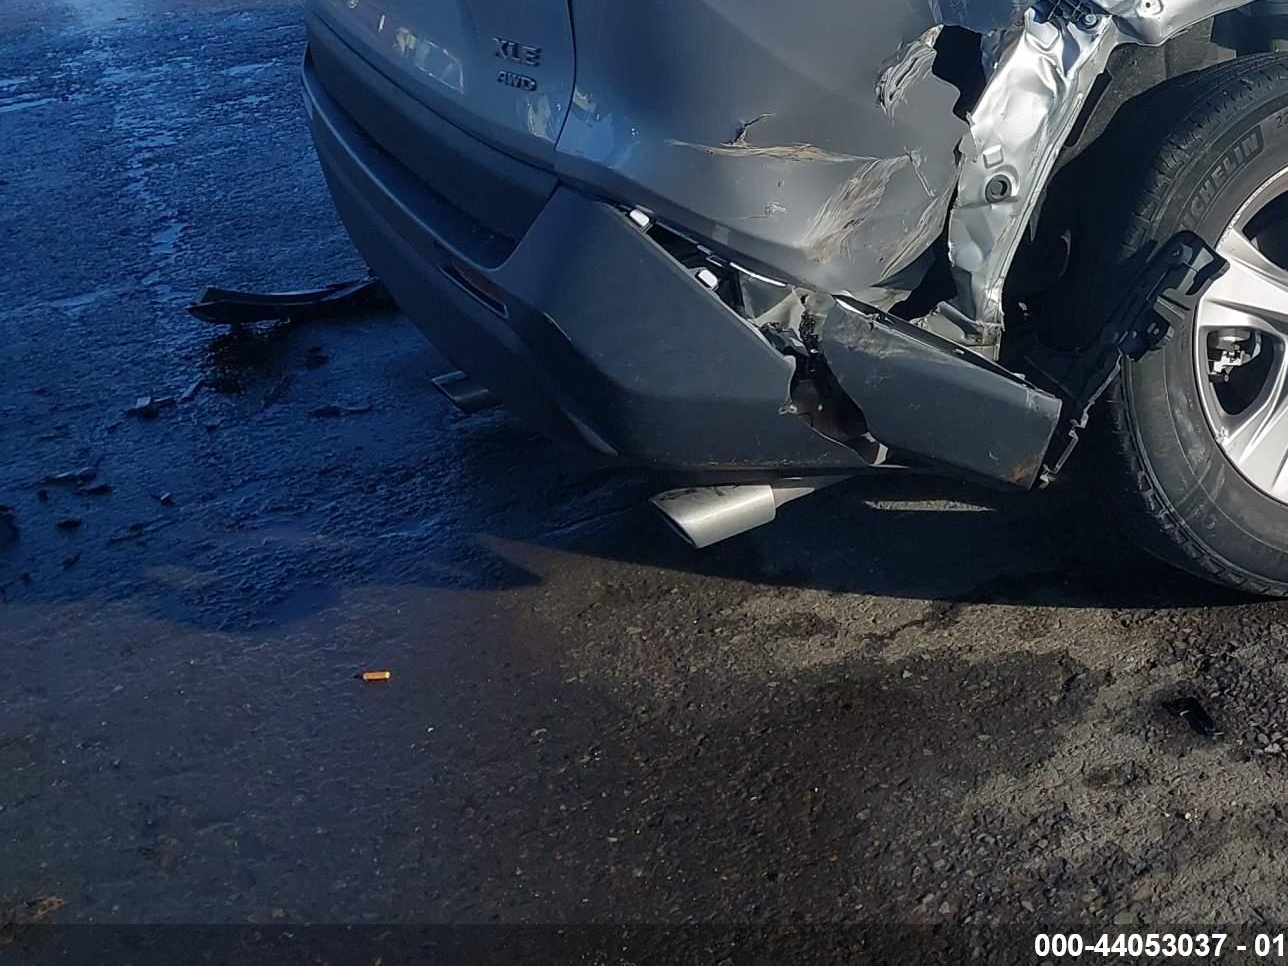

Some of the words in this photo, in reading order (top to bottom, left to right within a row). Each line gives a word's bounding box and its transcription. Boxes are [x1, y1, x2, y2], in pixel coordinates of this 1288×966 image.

[493, 37, 541, 66] XLE
[497, 71, 537, 91] AWD
[1181, 131, 1260, 230] ICHELIN
